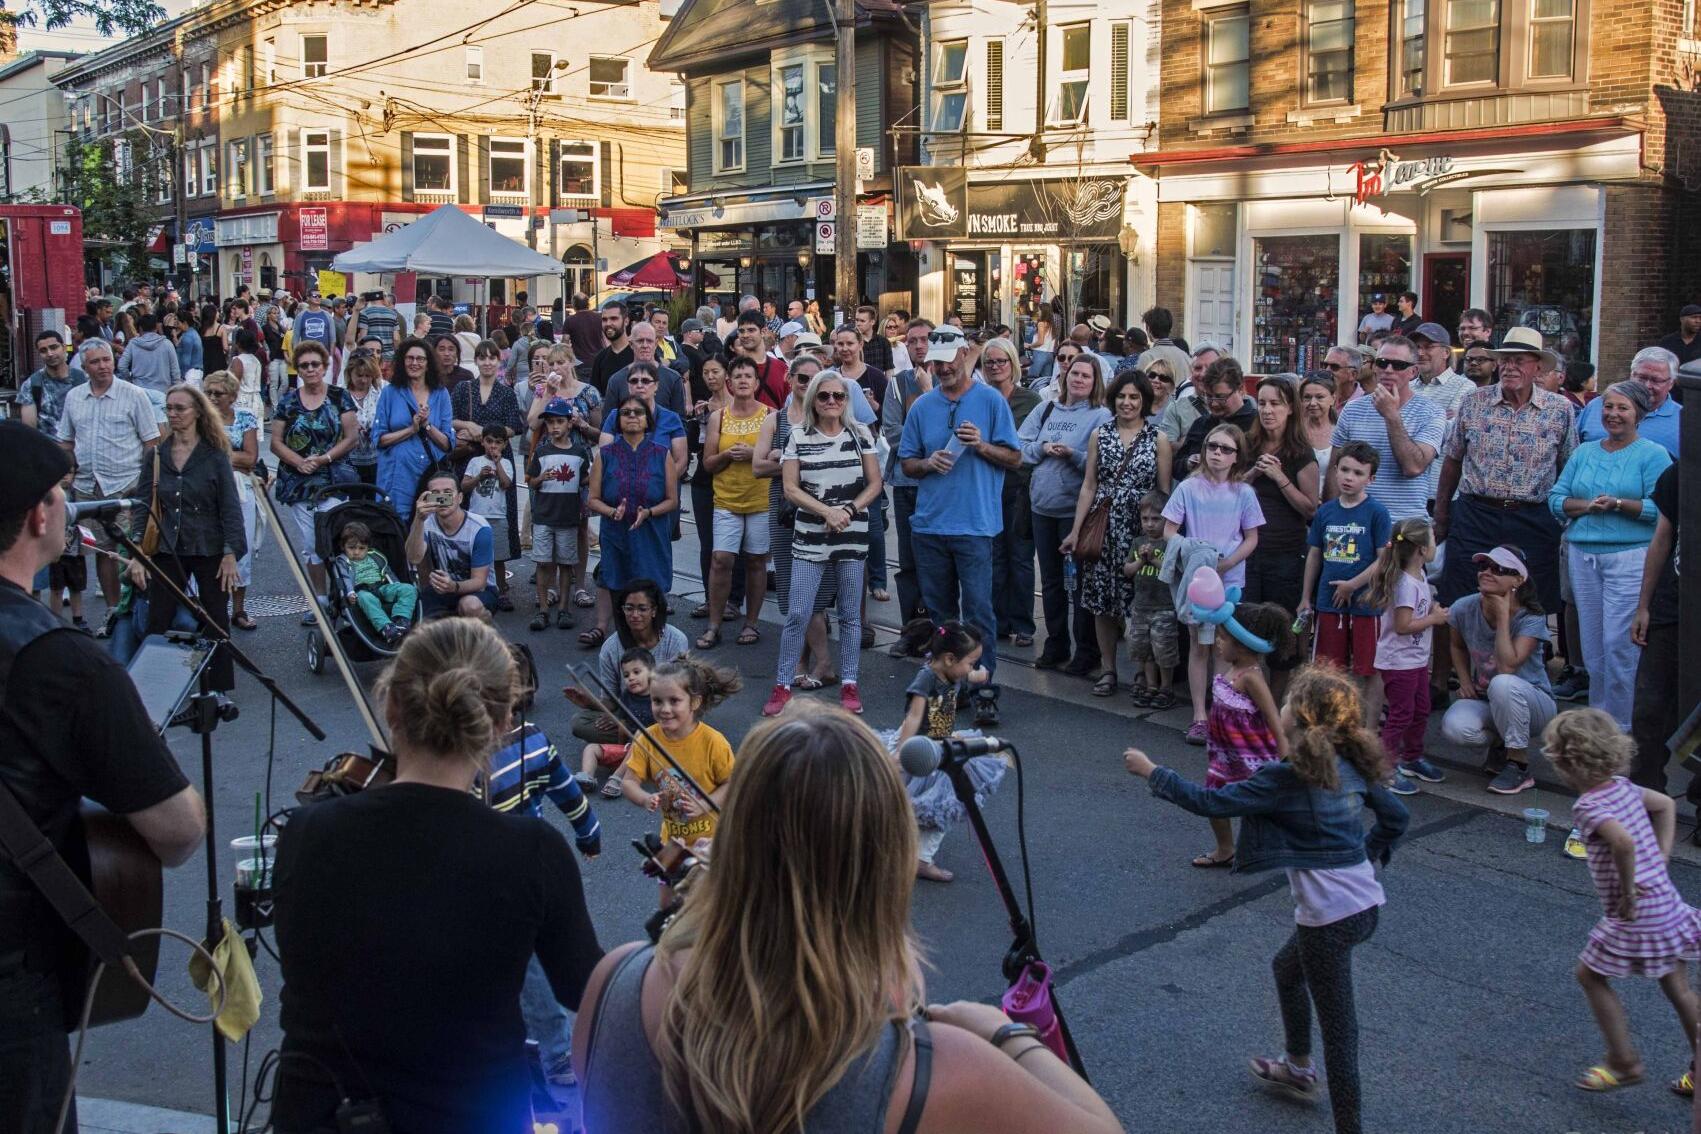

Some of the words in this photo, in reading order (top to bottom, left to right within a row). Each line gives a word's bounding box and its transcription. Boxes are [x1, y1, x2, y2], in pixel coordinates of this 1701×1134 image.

[1438, 172, 1469, 183] COLLECTIBLES
[301, 214, 311, 226] FOR
[311, 214, 326, 226] LEASE
[660, 213, 705, 227] WHITLOCK'S
[1020, 223, 1034, 232] TRUE
[1047, 422, 1078, 432] QUEBEC
